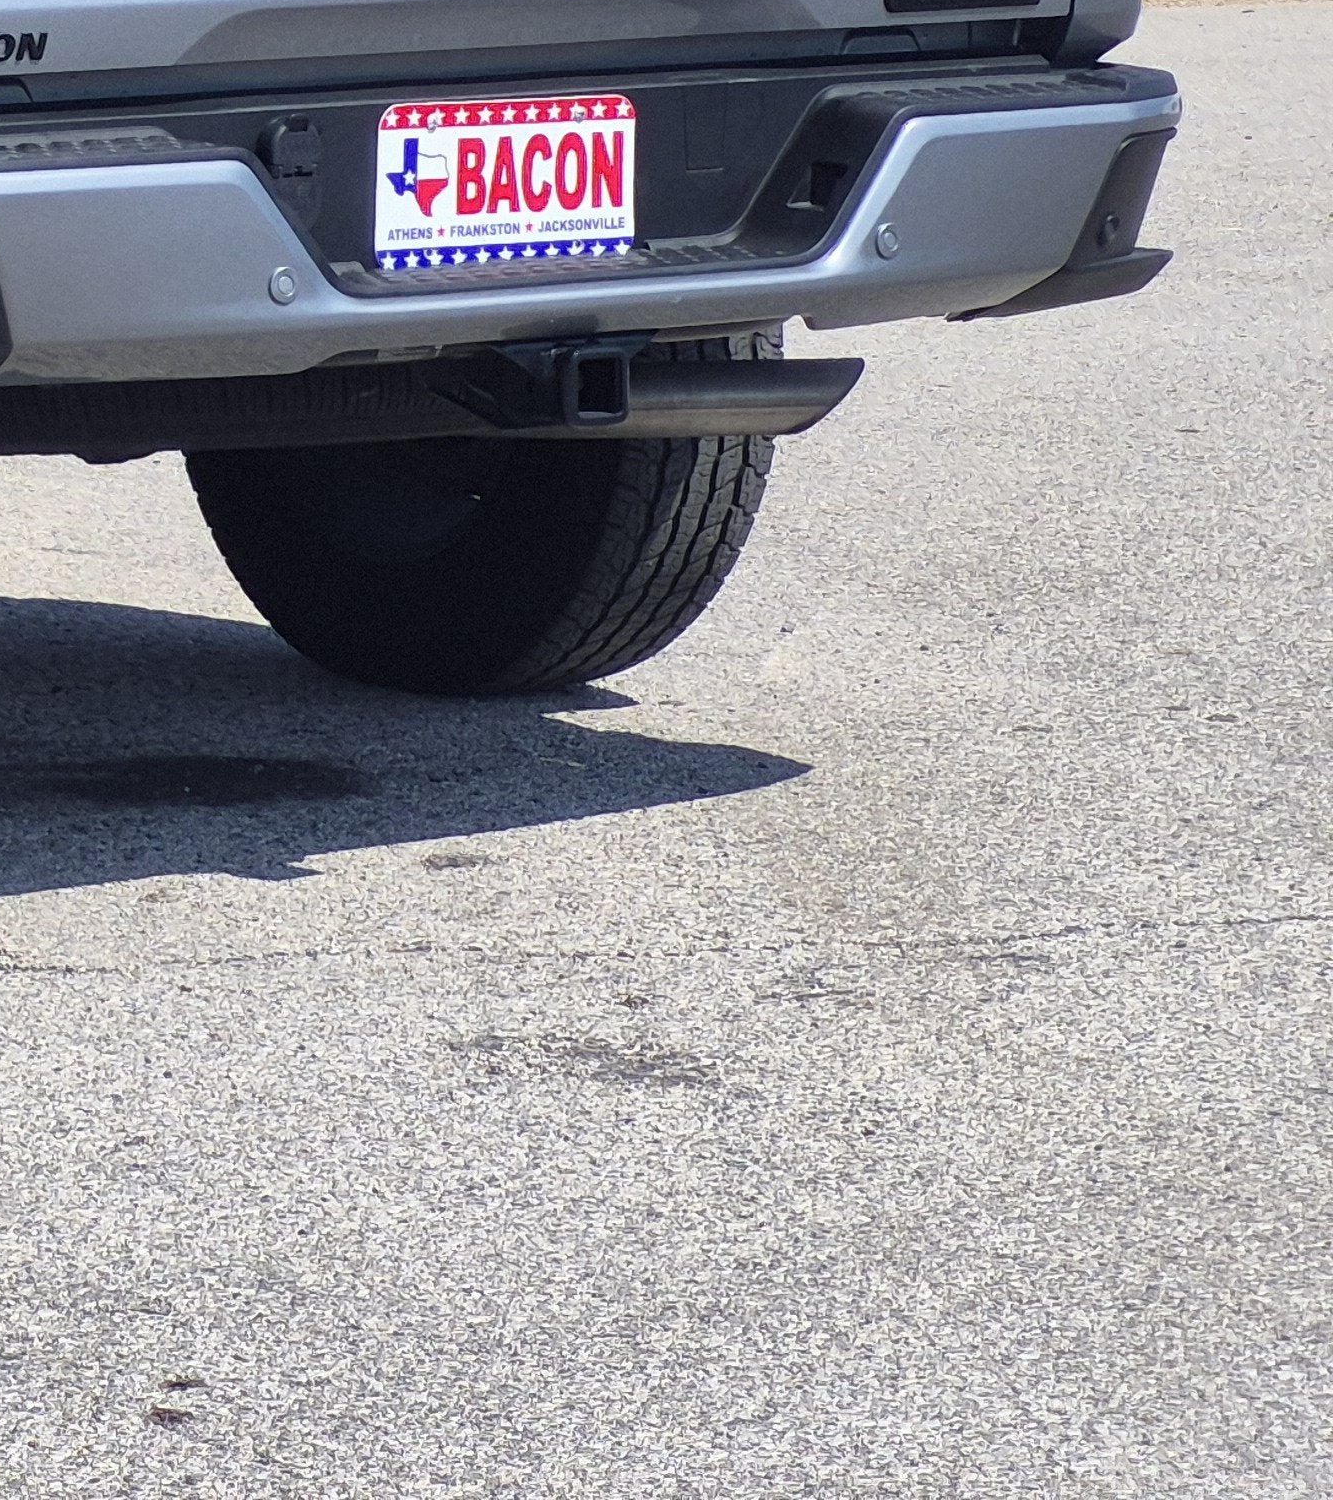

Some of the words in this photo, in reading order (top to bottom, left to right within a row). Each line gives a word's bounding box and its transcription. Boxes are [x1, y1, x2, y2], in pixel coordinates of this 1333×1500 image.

[456, 131, 624, 215] BACON
[388, 227, 433, 241] ATHENS
[450, 222, 521, 238] FRANKSTON
[538, 217, 626, 234] JACKSONVILLE
